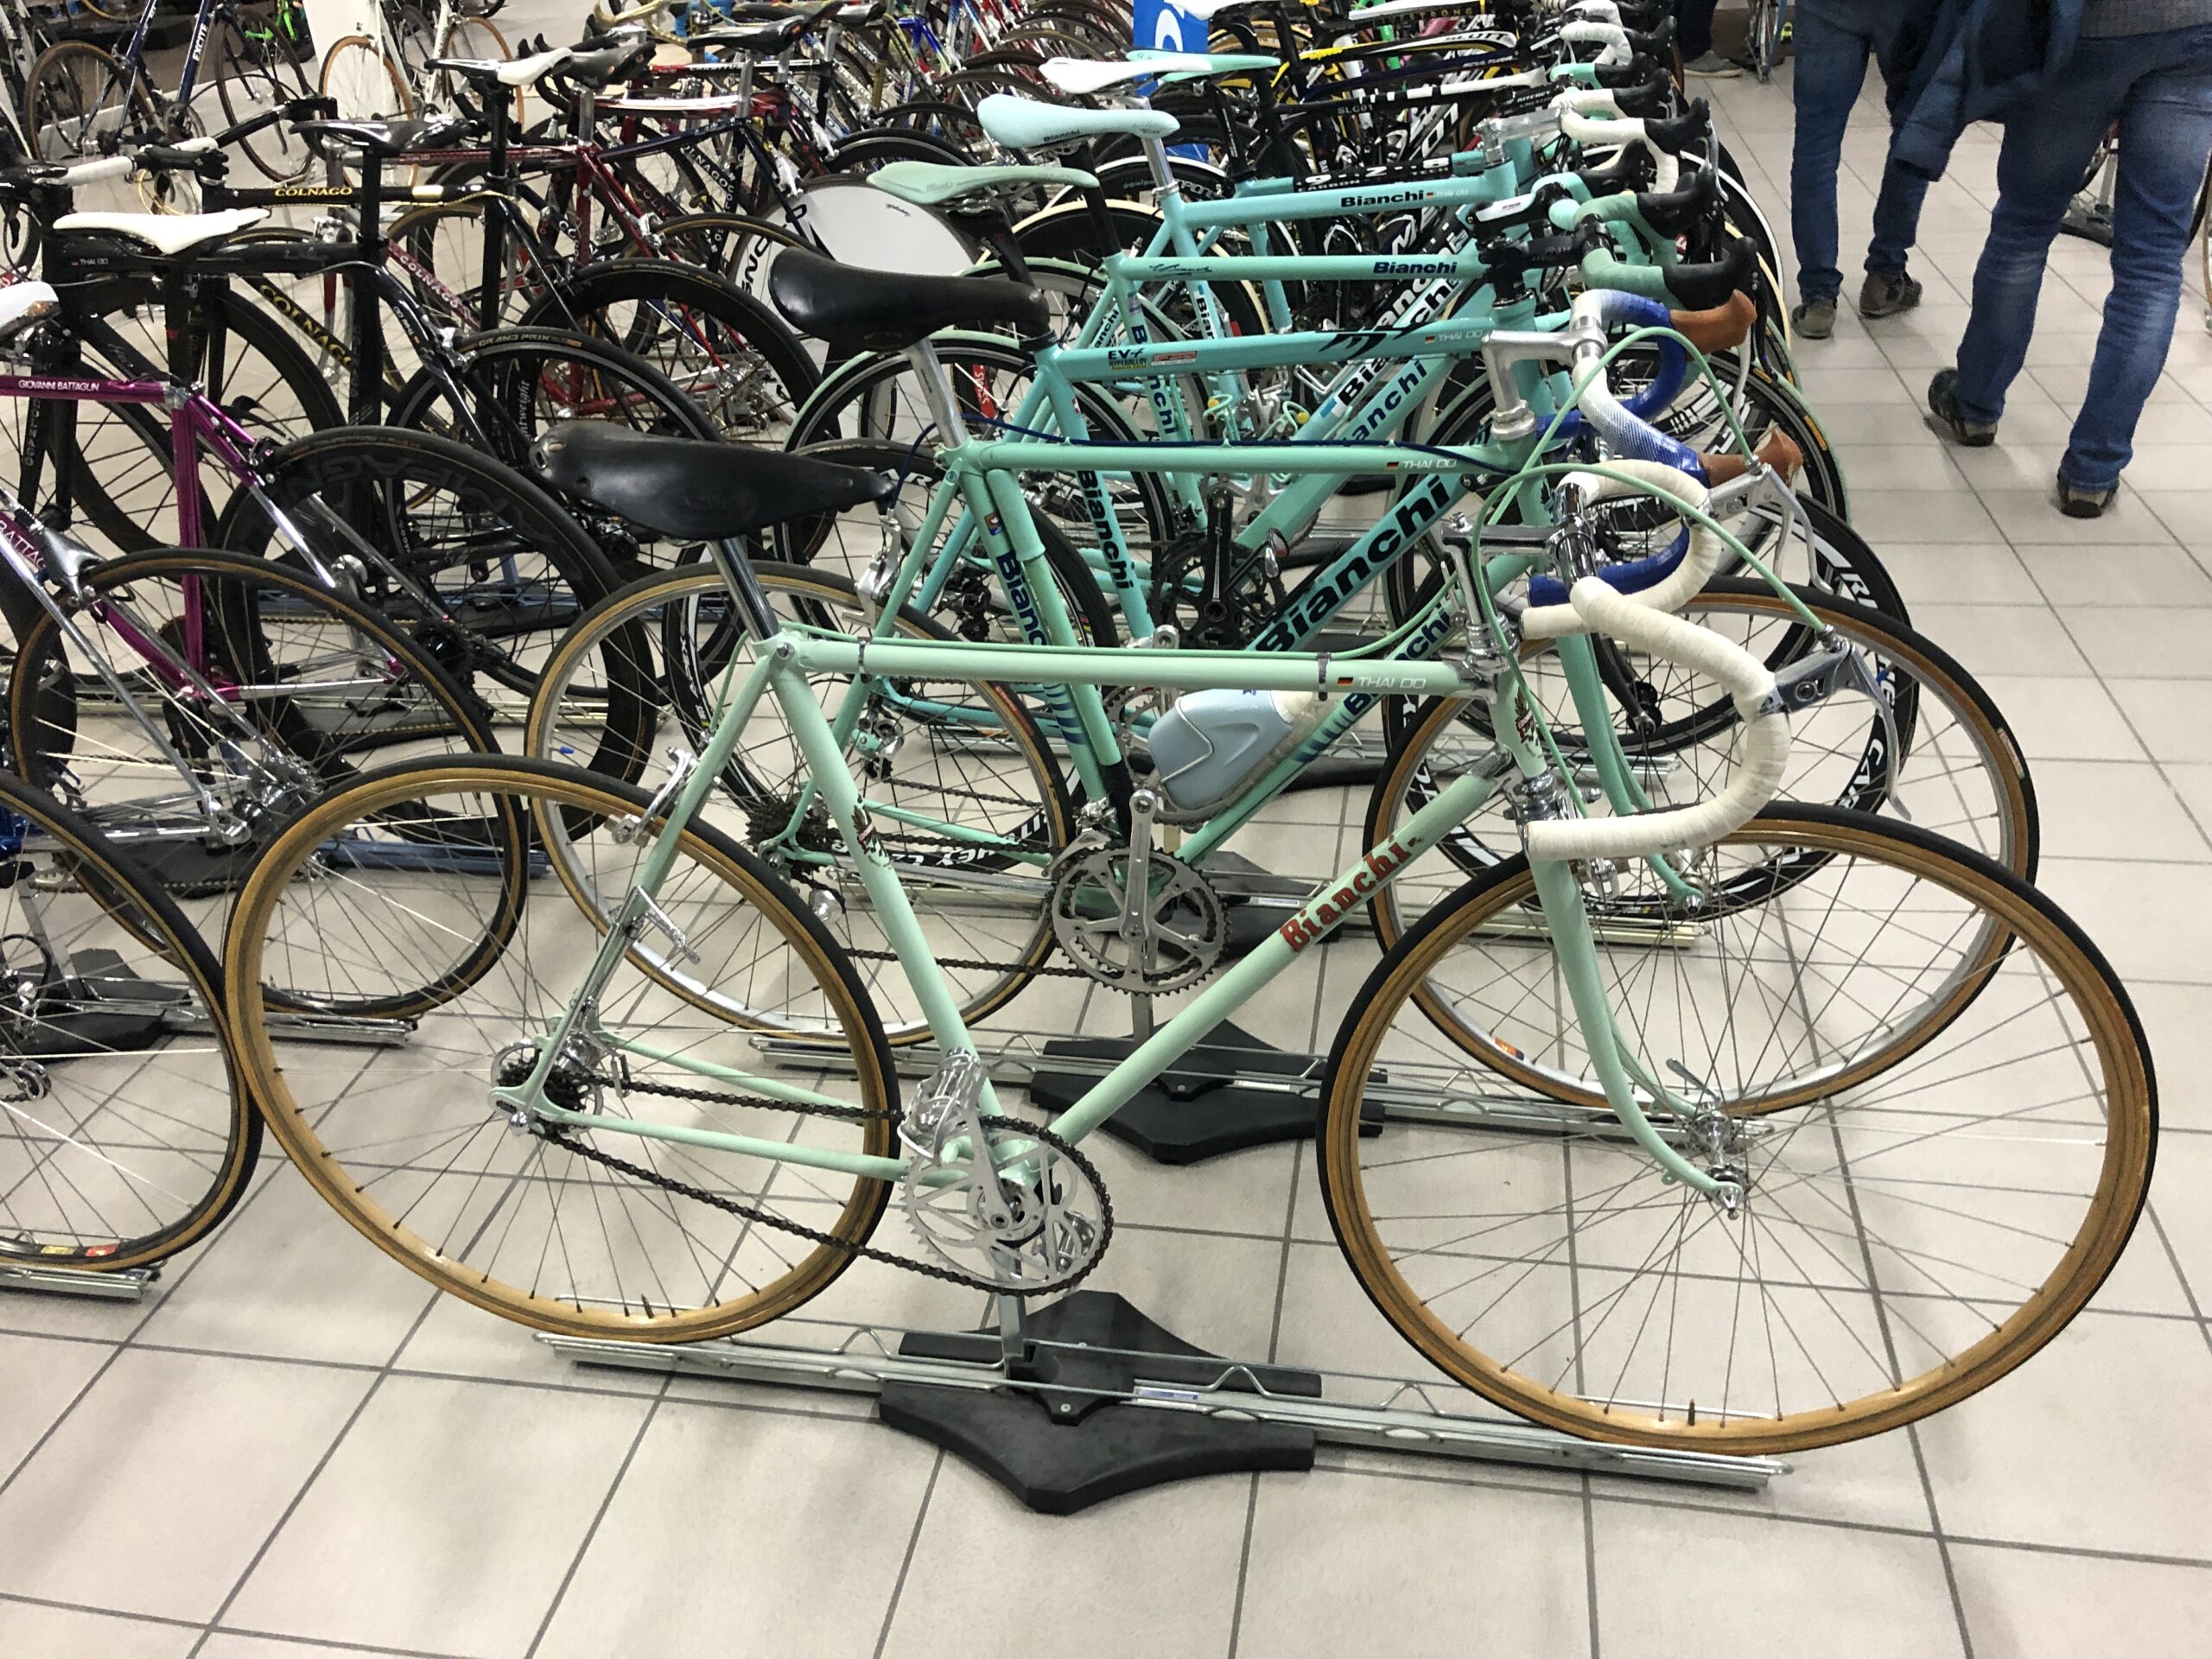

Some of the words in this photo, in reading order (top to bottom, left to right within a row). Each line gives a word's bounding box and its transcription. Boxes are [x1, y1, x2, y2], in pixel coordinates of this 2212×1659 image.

[275, 187, 353, 197] COLNAGO
[1341, 190, 1424, 208] Bianchi
[399, 256, 461, 308] COLNAGO
[1373, 262, 1458, 274] Bianchi
[479, 334, 518, 346] GRAND
[520, 334, 551, 342] PRIX
[18, 379, 56, 390] GIOVANNI
[57, 381, 99, 391] BATTAGLIN
[518, 380, 532, 442] ghtweight
[1403, 460, 1432, 469] THAI
[1436, 459, 1457, 468] DO
[0, 519, 46, 569] BATTAG
[1077, 471, 1135, 589] Bianchi
[1255, 474, 1450, 652] Bianchi
[995, 550, 1047, 645] Bianc
[1358, 677, 1395, 688] THAI
[1399, 677, 1427, 689] DO
[1280, 834, 1412, 953] Bianchi
